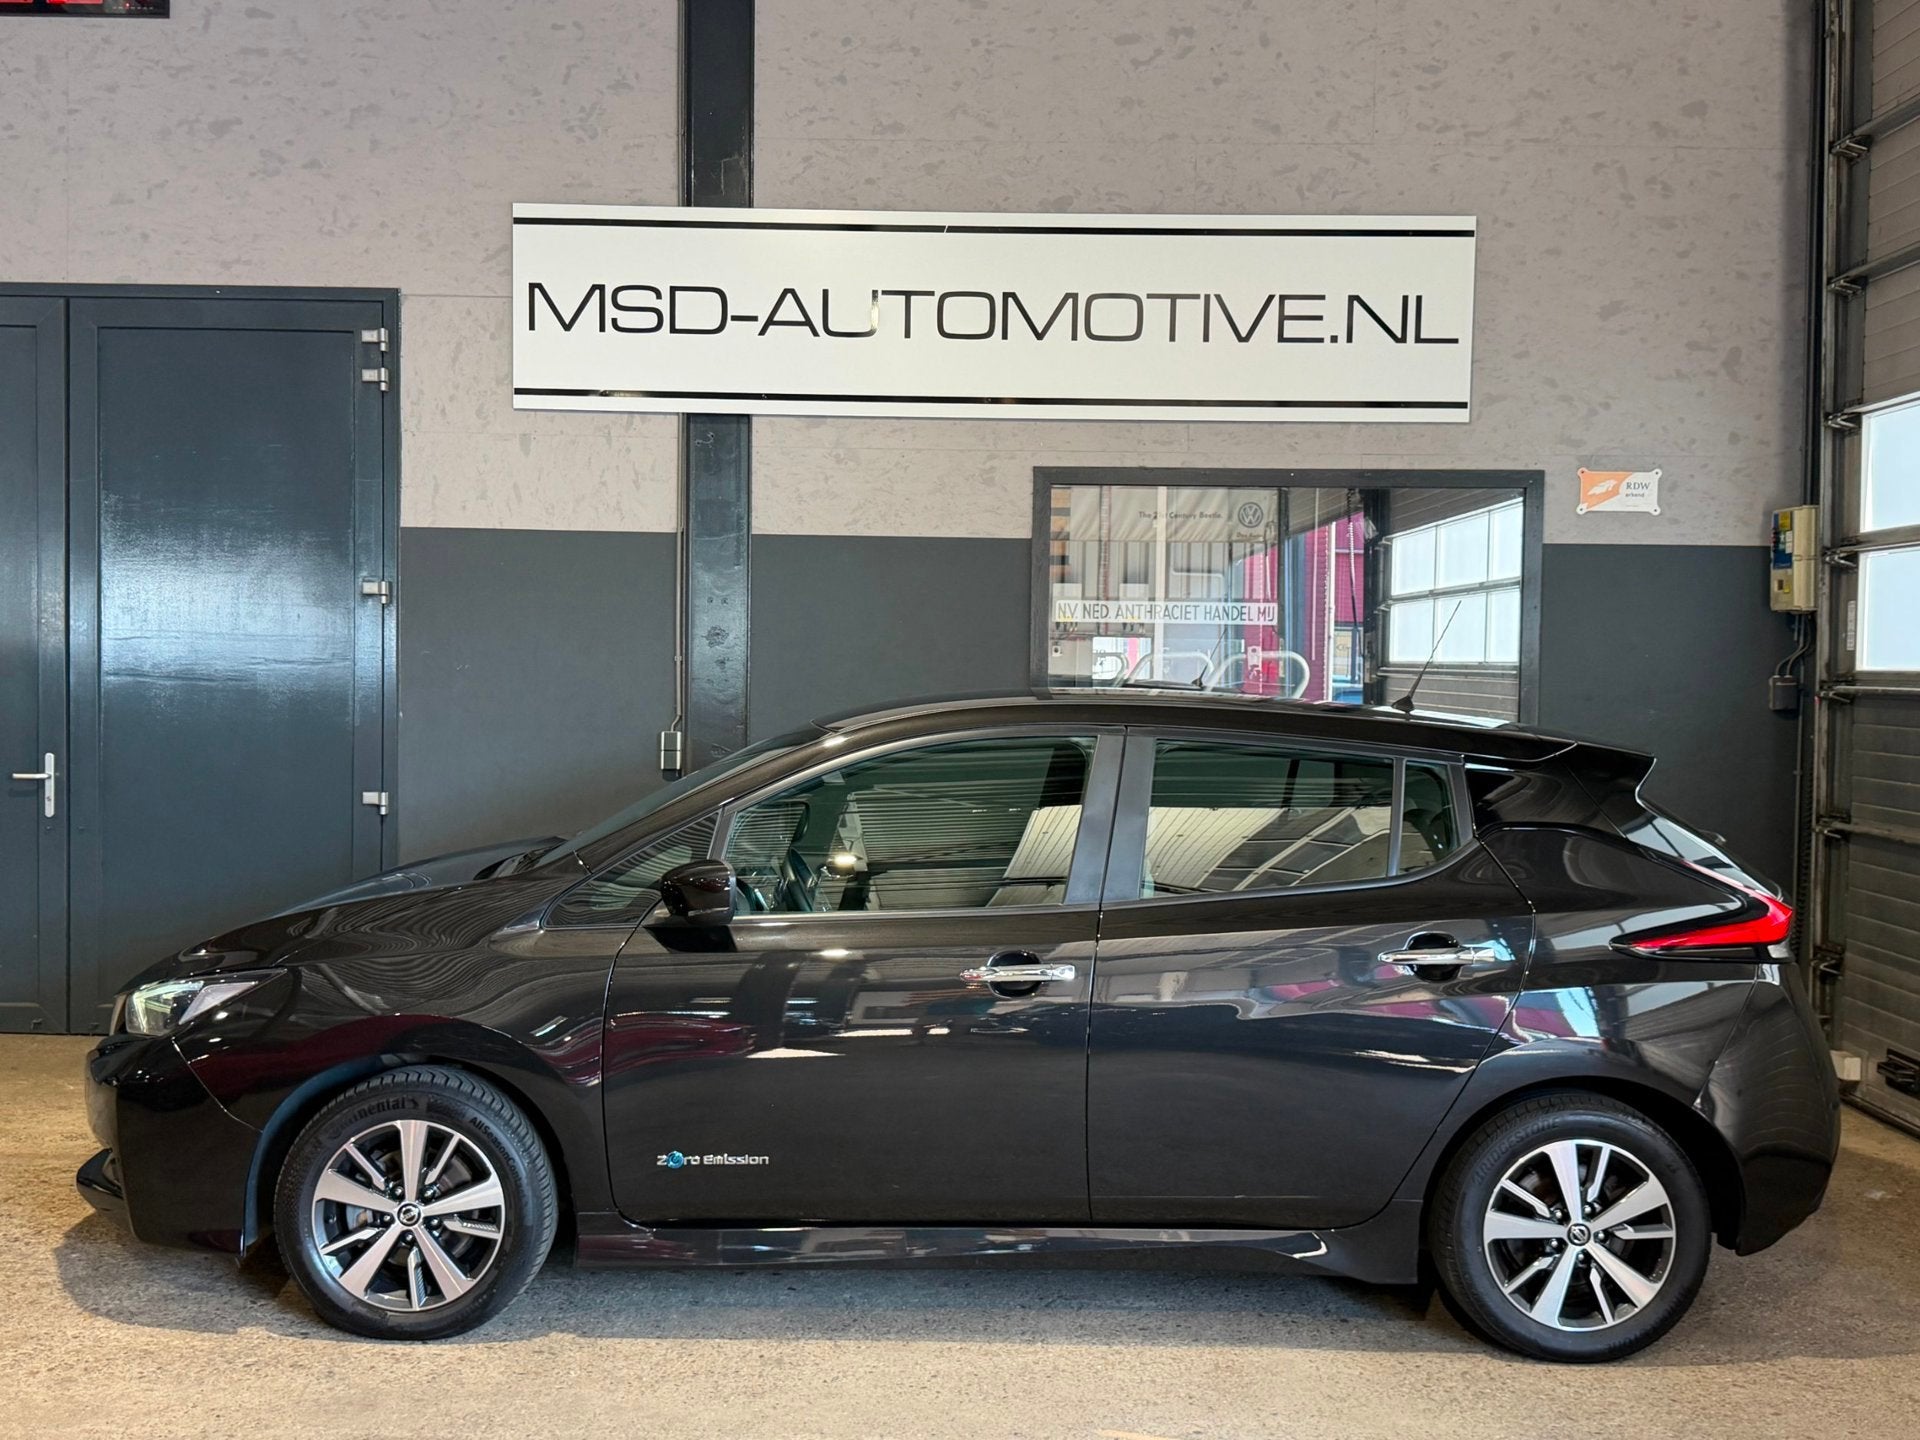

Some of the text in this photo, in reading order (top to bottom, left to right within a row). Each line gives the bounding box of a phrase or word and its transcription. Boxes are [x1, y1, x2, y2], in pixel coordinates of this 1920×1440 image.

[528, 283, 1459, 344] MSD-AUTOMOTIVE.NL
[1626, 482, 1650, 490] RDW
[1139, 511, 1151, 519] The
[1168, 511, 1197, 520] Century
[1057, 604, 1078, 620] N.V.
[1082, 604, 1111, 620] NED.
[1115, 604, 1200, 621] ANTHRACIET
[1203, 604, 1254, 621] HANDEL
[703, 1153, 770, 1166] Emission
